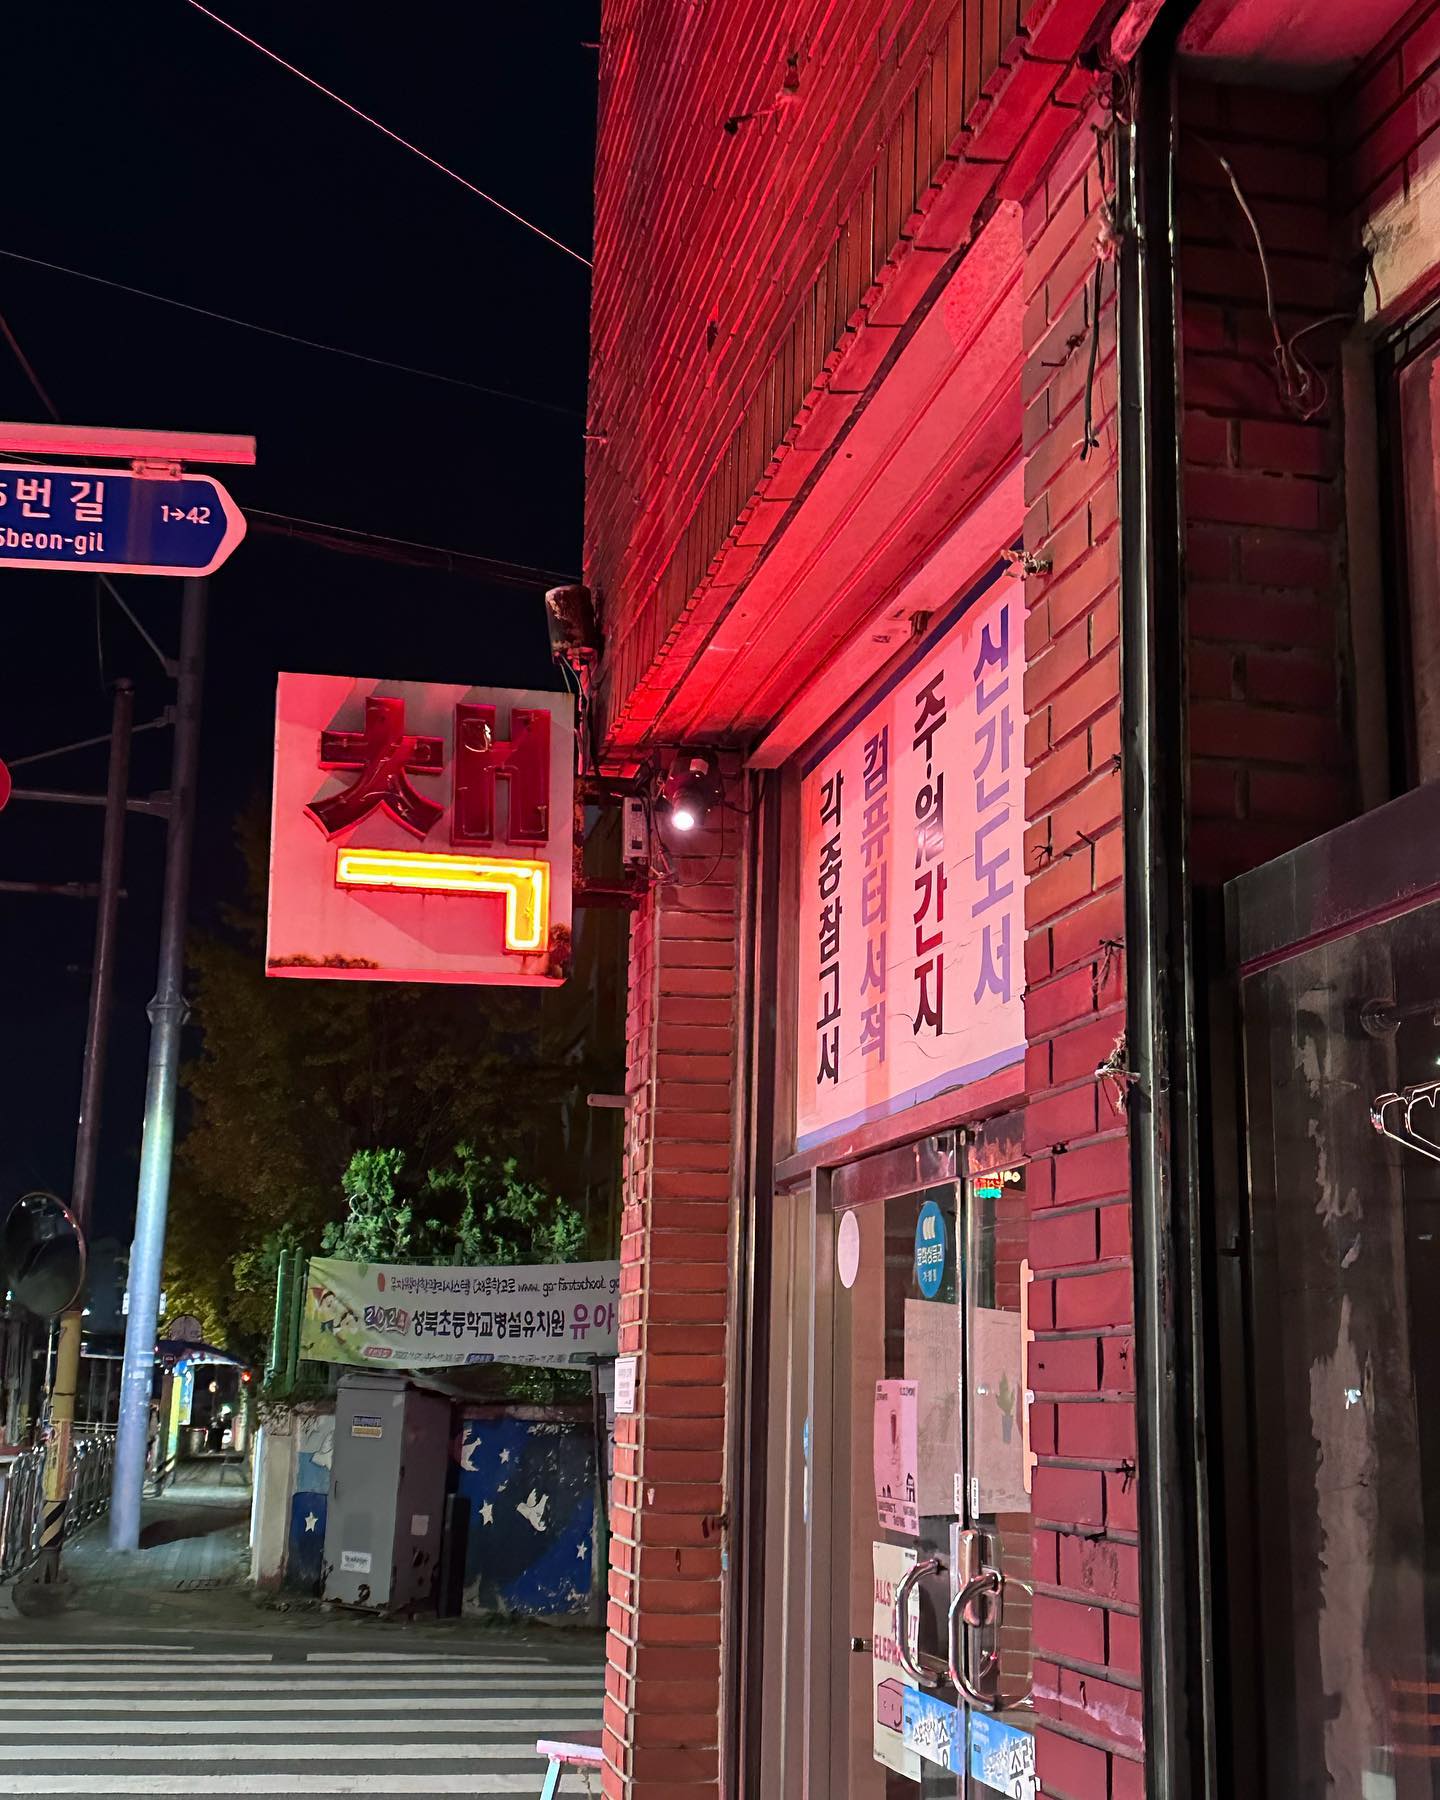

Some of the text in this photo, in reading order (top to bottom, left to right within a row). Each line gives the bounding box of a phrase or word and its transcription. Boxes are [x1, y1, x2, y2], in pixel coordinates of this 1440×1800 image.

[303, 696, 552, 955] 책
[972, 604, 1014, 1006] 신간도서
[412, 1309, 565, 1339] 성북초등학교병설유치원
